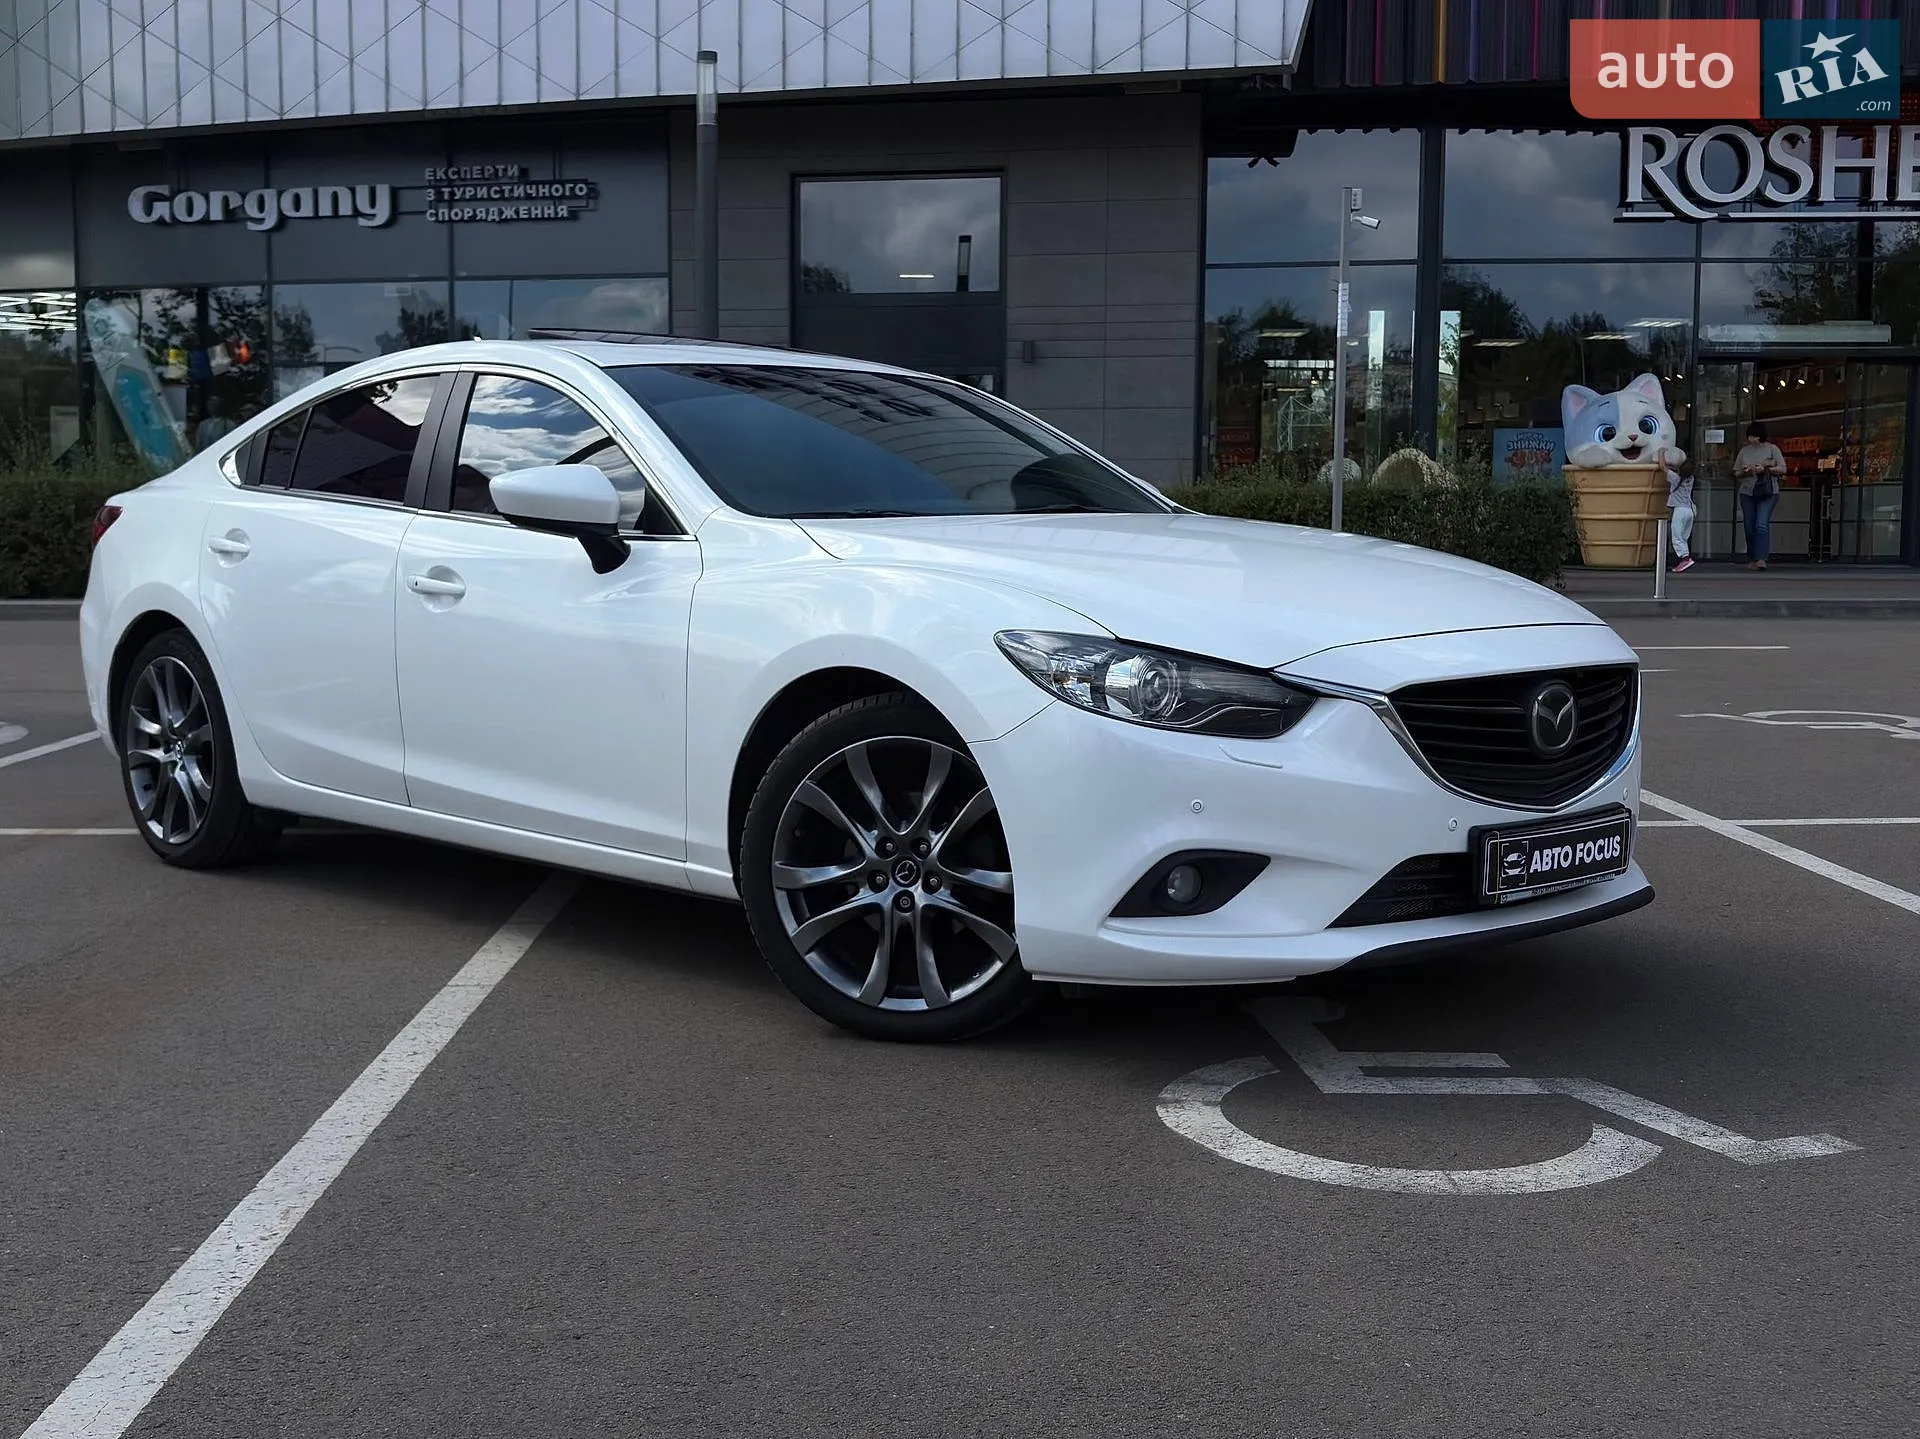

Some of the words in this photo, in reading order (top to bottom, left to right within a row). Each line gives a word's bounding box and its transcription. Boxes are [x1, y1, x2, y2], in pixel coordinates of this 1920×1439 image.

[425, 164, 519, 180] ЕКСПЕРТИ
[442, 183, 588, 200] ТУРИСТИЧНОГО
[127, 184, 391, 231] Gorgany
[426, 205, 569, 221] СПОРЯДЖЕННЯ
[1575, 835, 1621, 866] FOCUS
